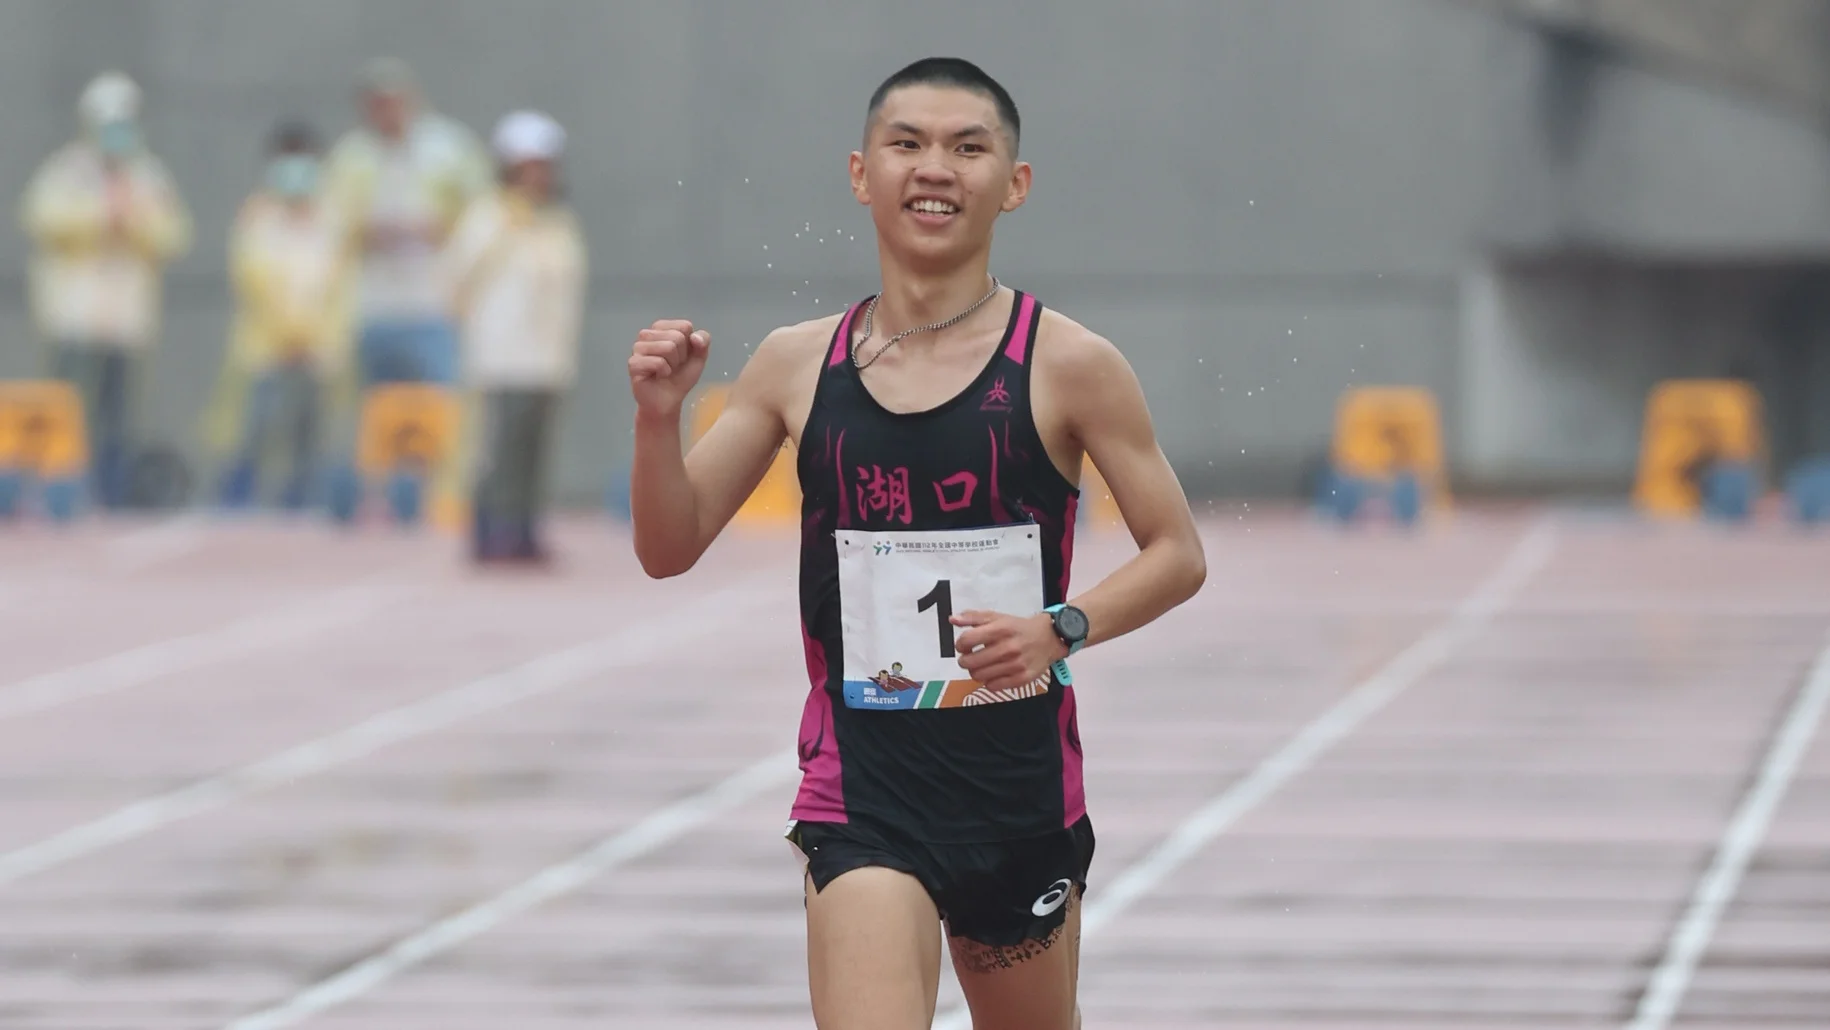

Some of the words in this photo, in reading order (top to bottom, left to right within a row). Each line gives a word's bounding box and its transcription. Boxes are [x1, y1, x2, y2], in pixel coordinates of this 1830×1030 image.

[856, 464, 978, 525] 湖口
[917, 579, 956, 658] 1
[863, 696, 900, 704] ATHLETICS
